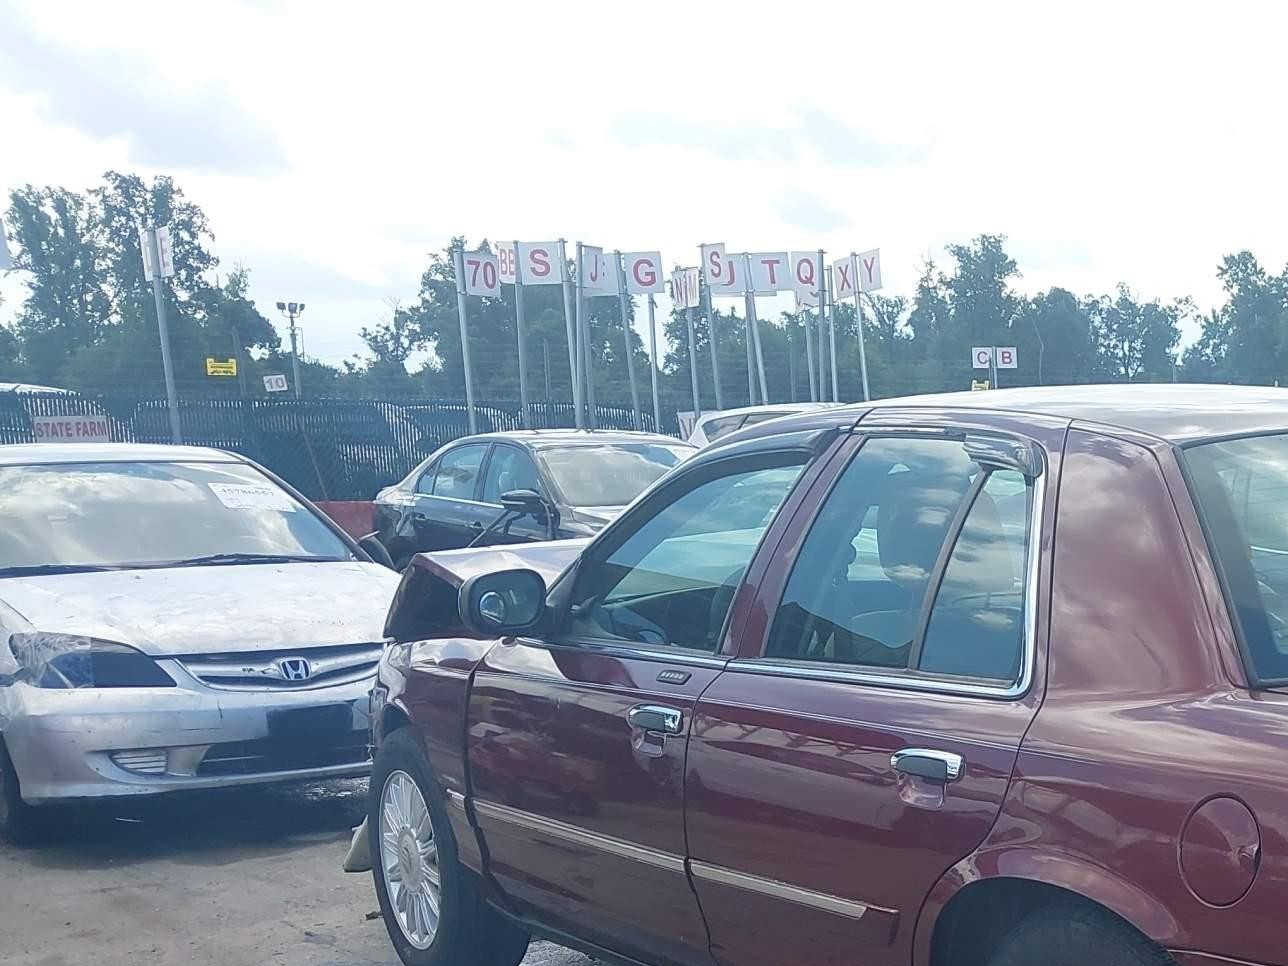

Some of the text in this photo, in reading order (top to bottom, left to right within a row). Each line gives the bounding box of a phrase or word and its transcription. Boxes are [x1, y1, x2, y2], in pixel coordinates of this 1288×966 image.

[467, 260, 496, 289] 70
[529, 248, 551, 277] S
[632, 258, 657, 287] G
[709, 250, 722, 278] S
[761, 259, 781, 285] T
[796, 258, 815, 287] Q
[863, 256, 875, 284] Y
[838, 264, 852, 292] X
[977, 351, 1013, 365] C B
[265, 377, 285, 389] 10
[36, 421, 107, 438] STATE FARM
